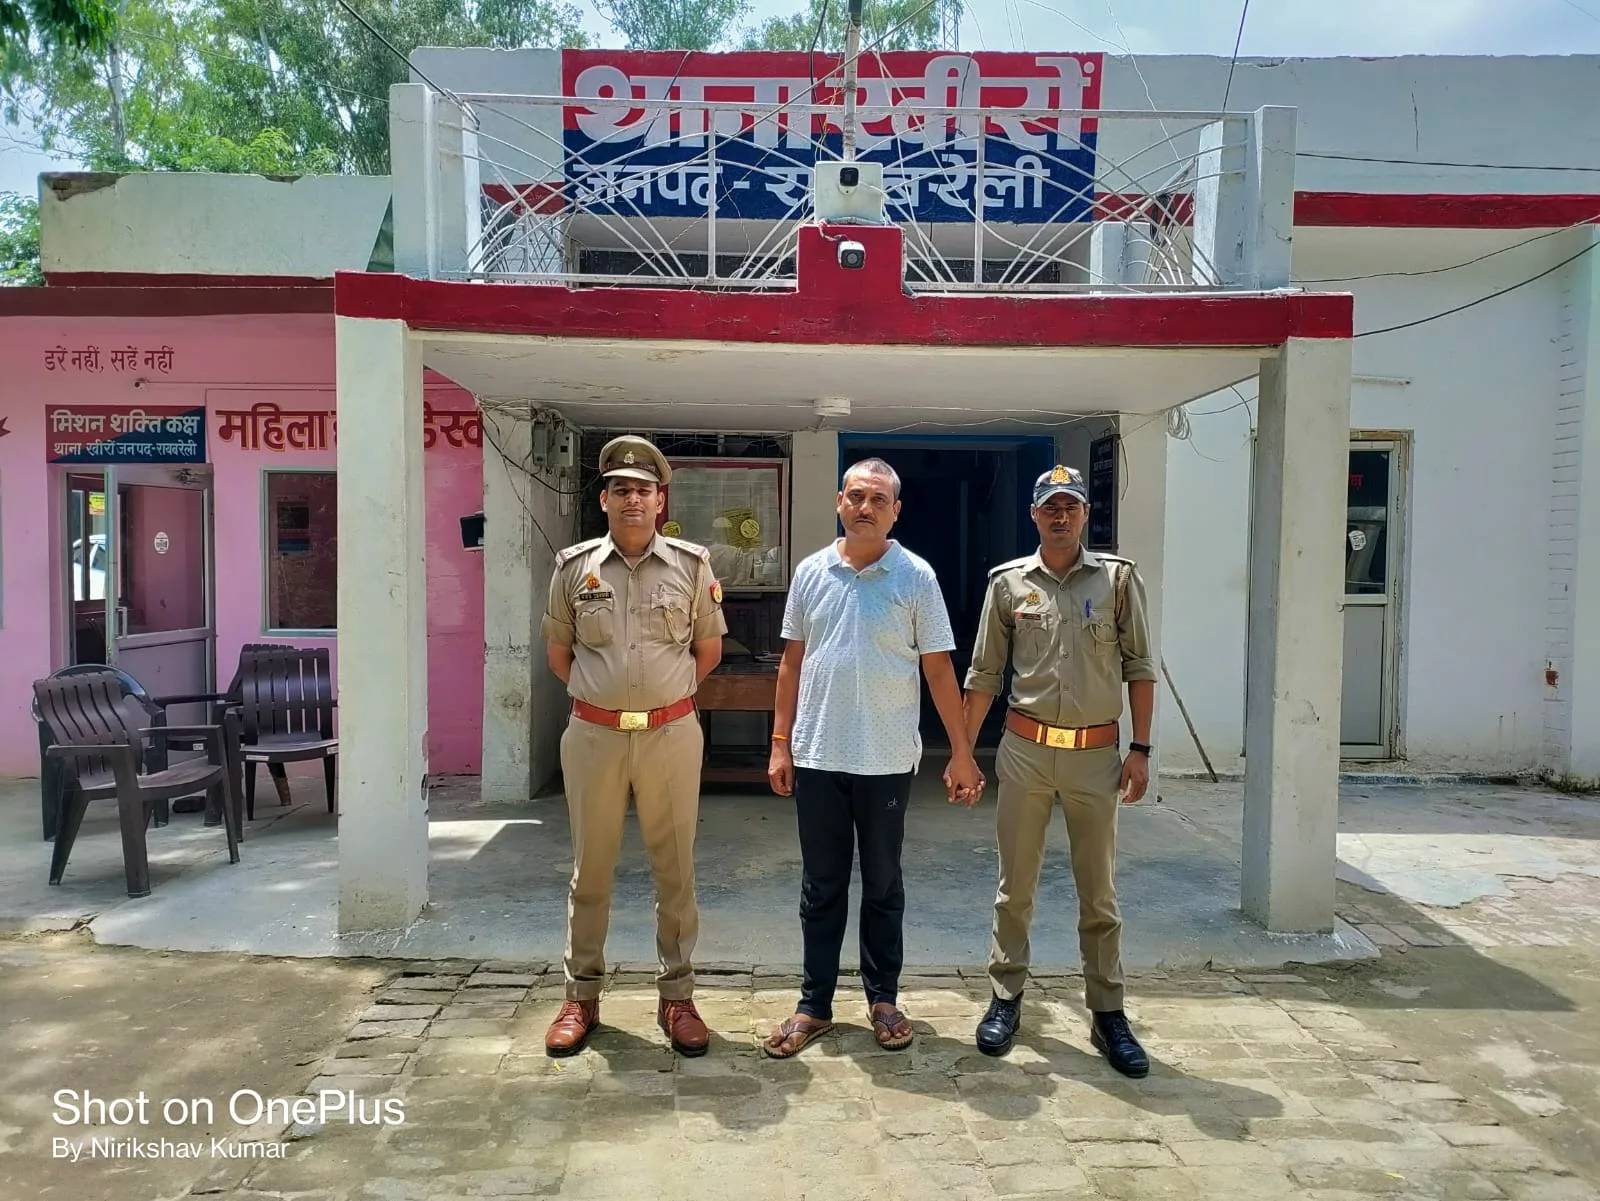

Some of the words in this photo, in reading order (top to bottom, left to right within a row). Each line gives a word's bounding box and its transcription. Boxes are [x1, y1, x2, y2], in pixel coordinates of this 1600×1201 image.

[574, 64, 818, 149] थाना
[44, 345, 68, 371] डरें
[110, 345, 138, 372] सहें
[144, 345, 175, 374] नहीं
[50, 409, 106, 433] मिशन
[110, 409, 165, 433] शक्ति
[165, 415, 201, 435] कक्ष
[215, 402, 329, 452] महिला
[54, 442, 82, 456] थाना
